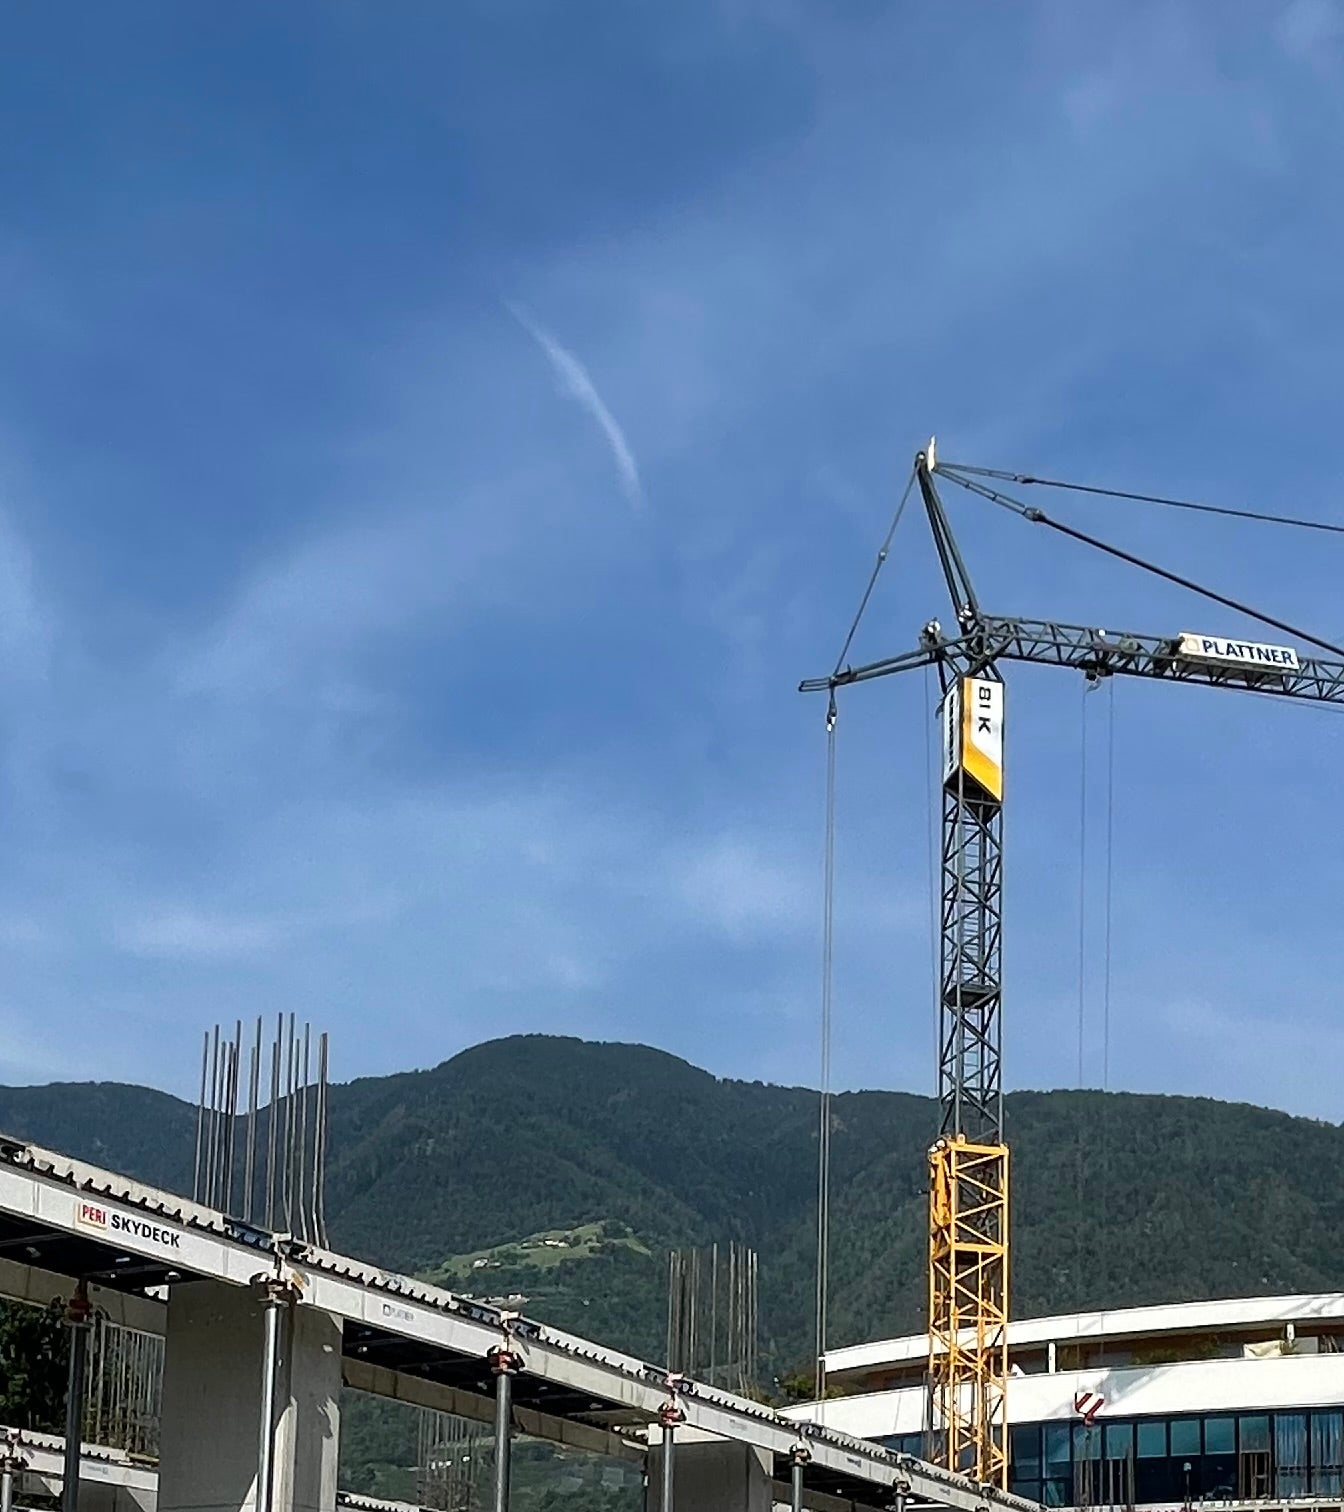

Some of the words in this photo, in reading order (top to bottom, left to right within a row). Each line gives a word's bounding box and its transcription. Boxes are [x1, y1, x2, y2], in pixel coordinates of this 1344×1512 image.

[1202, 639, 1295, 665] PLATTNER
[82, 1204, 107, 1225] PERI
[111, 1214, 180, 1248] SKYDECK
